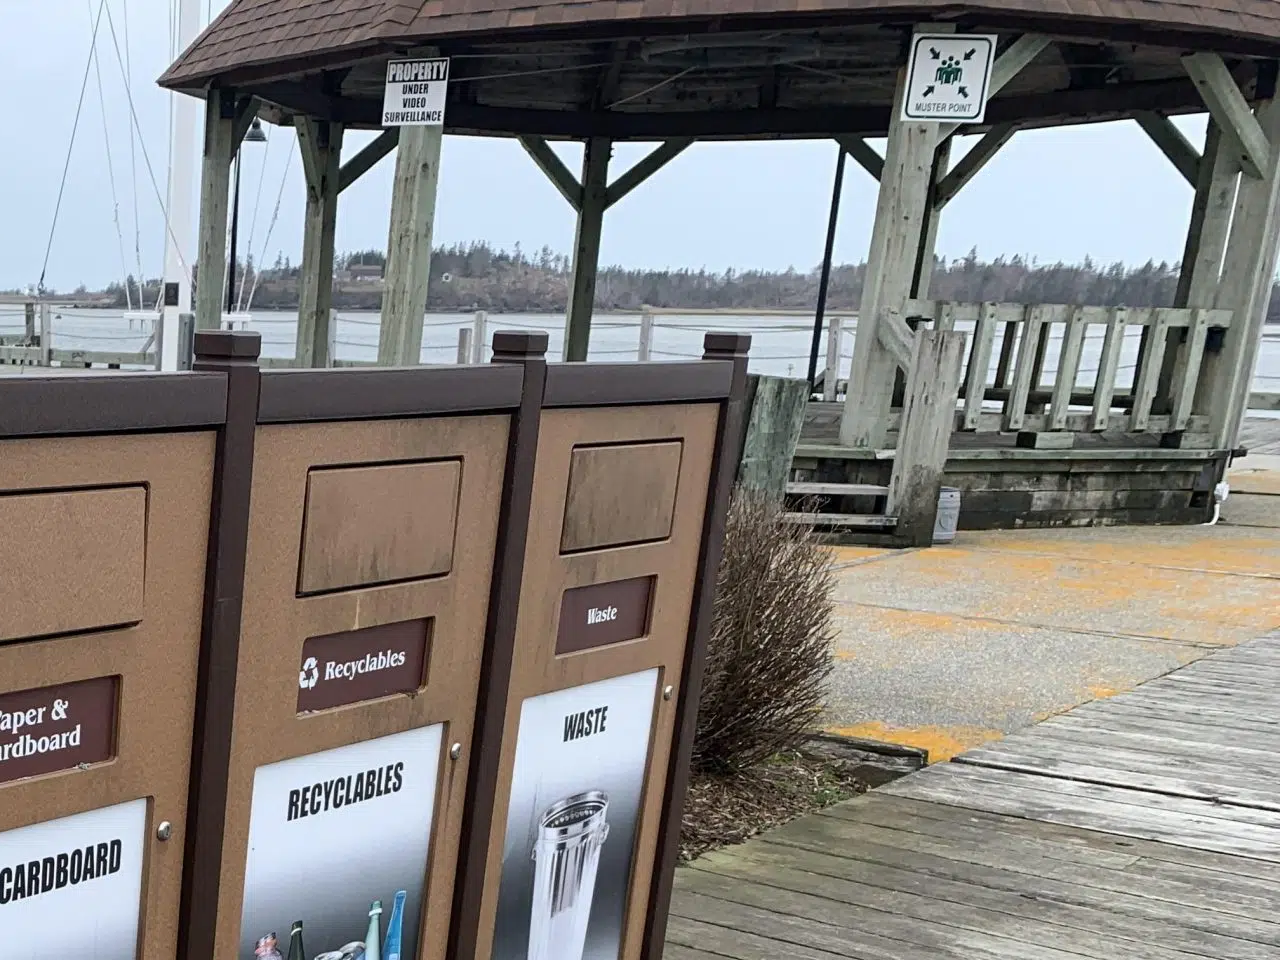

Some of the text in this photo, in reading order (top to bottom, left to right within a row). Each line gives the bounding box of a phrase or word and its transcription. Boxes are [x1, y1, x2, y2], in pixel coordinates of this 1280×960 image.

[388, 61, 447, 81] PROPERTY
[402, 83, 428, 94] UNDER
[402, 97, 426, 108] VIDEO
[915, 102, 972, 113] MUSTER POINT
[384, 110, 442, 123] SURVEILLANCE
[587, 605, 618, 625] Waste
[324, 650, 406, 681] Recyclables
[51, 698, 69, 721] &
[563, 706, 609, 742] WASTE
[287, 761, 405, 822] RECYCLABLES
